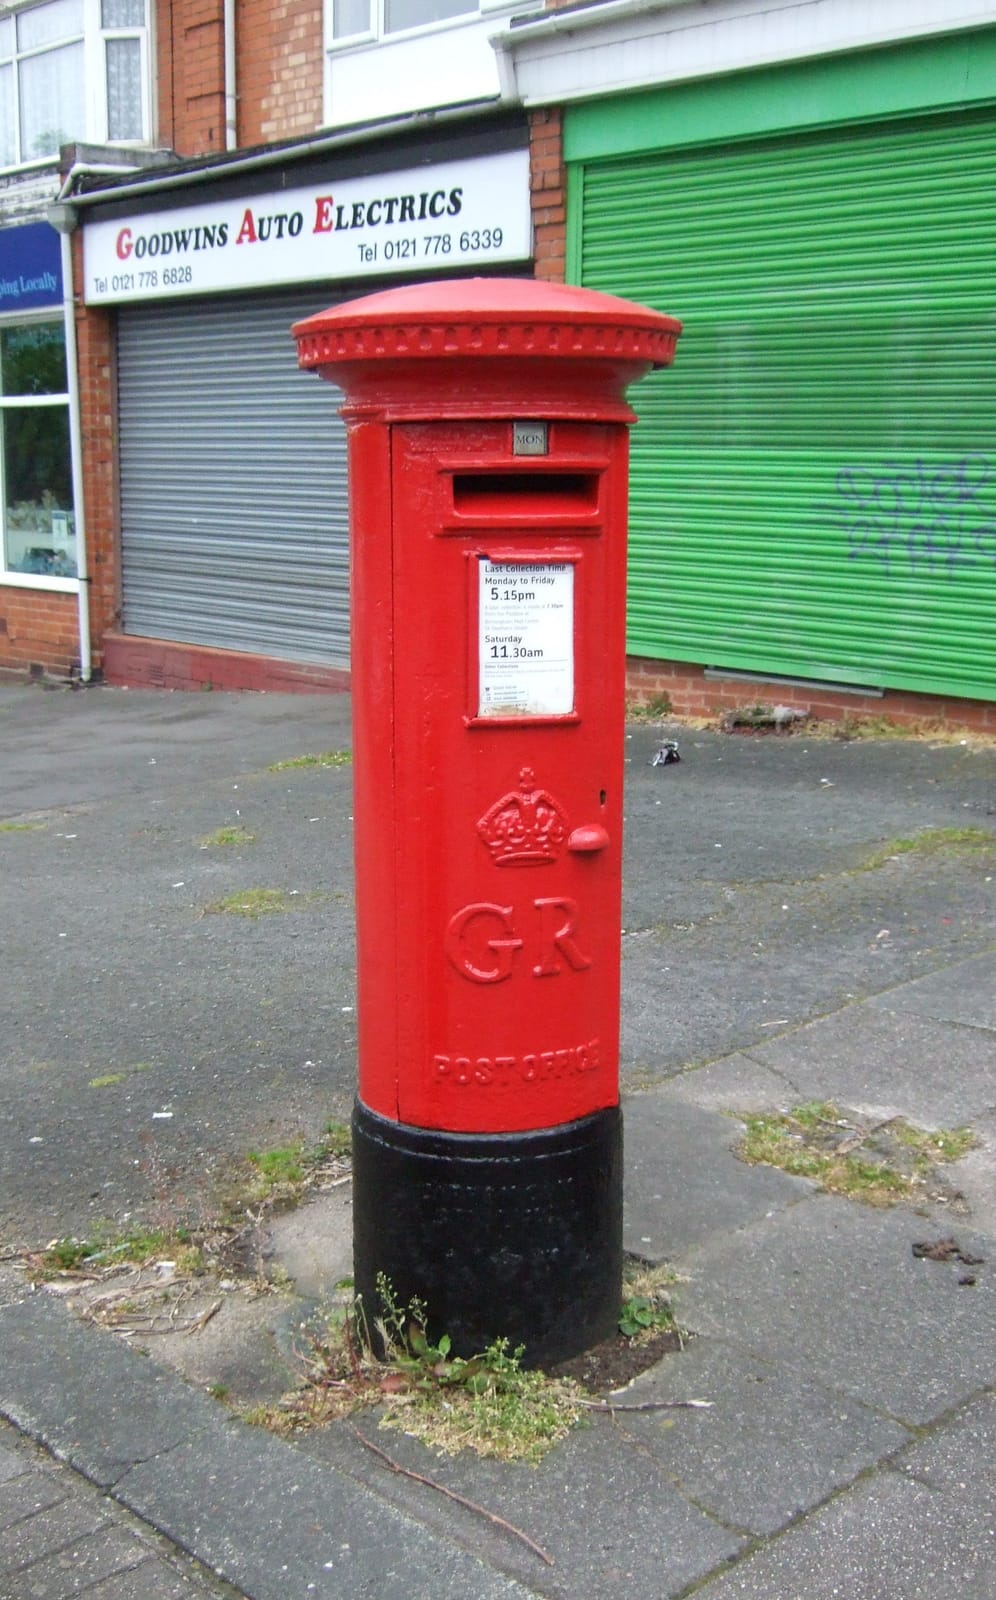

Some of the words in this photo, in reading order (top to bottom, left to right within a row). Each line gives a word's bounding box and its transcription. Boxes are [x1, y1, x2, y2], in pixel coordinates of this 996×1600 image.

[115, 222, 229, 261] GOODWINS
[235, 208, 304, 245] AUTO
[312, 187, 463, 234] ELECTRICS
[358, 242, 378, 263] Tel
[384, 238, 417, 260] 0121
[423, 233, 452, 256] 778
[459, 227, 504, 252] 6339
[19, 271, 57, 293] Locally
[94, 277, 108, 293] Tel
[111, 273, 135, 292] 0121
[139, 270, 159, 288] 778
[162, 265, 192, 286] 6828
[515, 434, 544, 445] MON
[484, 564, 503, 573] Last
[505, 564, 545, 573] Collection
[484, 577, 518, 587] Monday
[520, 577, 529, 585] to
[531, 576, 556, 586] Friday
[490, 586, 536, 603] 5.15pm
[484, 634, 523, 645] Saturday
[490, 645, 544, 659] 11.30am
[434, 1054, 516, 1086] POST
